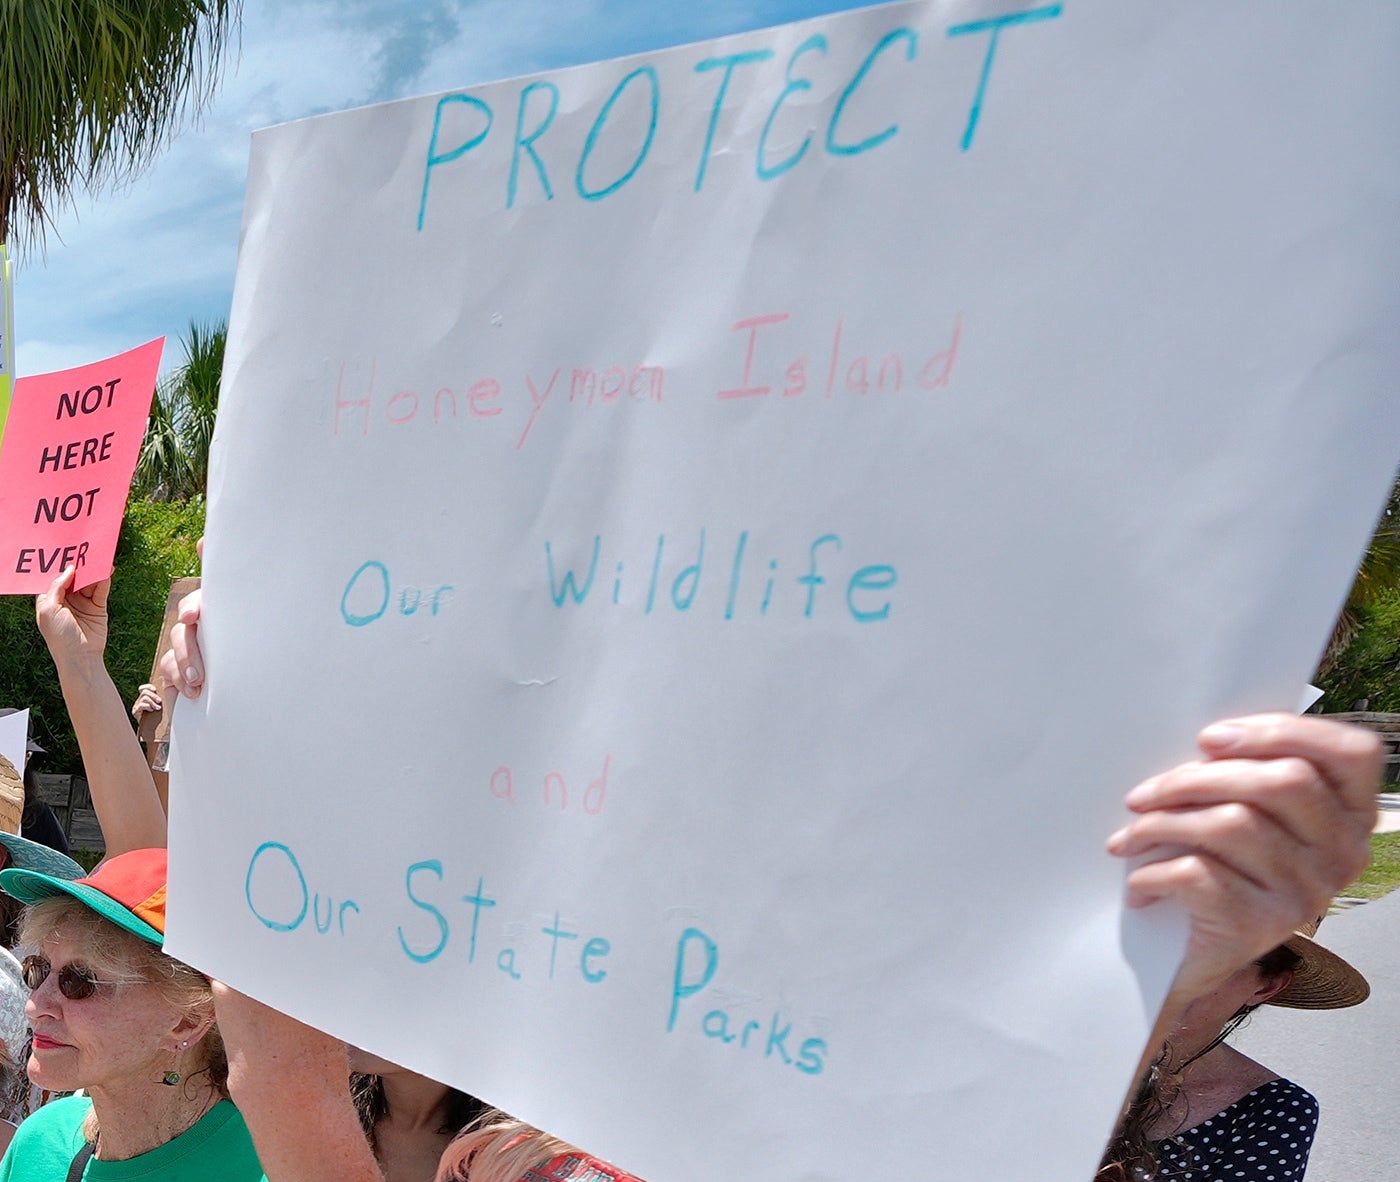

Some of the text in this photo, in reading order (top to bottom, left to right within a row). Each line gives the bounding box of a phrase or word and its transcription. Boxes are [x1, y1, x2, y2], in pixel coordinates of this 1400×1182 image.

[413, 3, 1063, 232] PROTECT
[55, 377, 122, 421] NOT
[330, 310, 966, 450] Honeymoon Island
[38, 431, 115, 474] HERE
[33, 487, 101, 525] NOT
[14, 540, 90, 575] EVER
[340, 529, 902, 628] Our Wildlife
[488, 752, 612, 819] and
[244, 838, 830, 1078] Our State Parks
